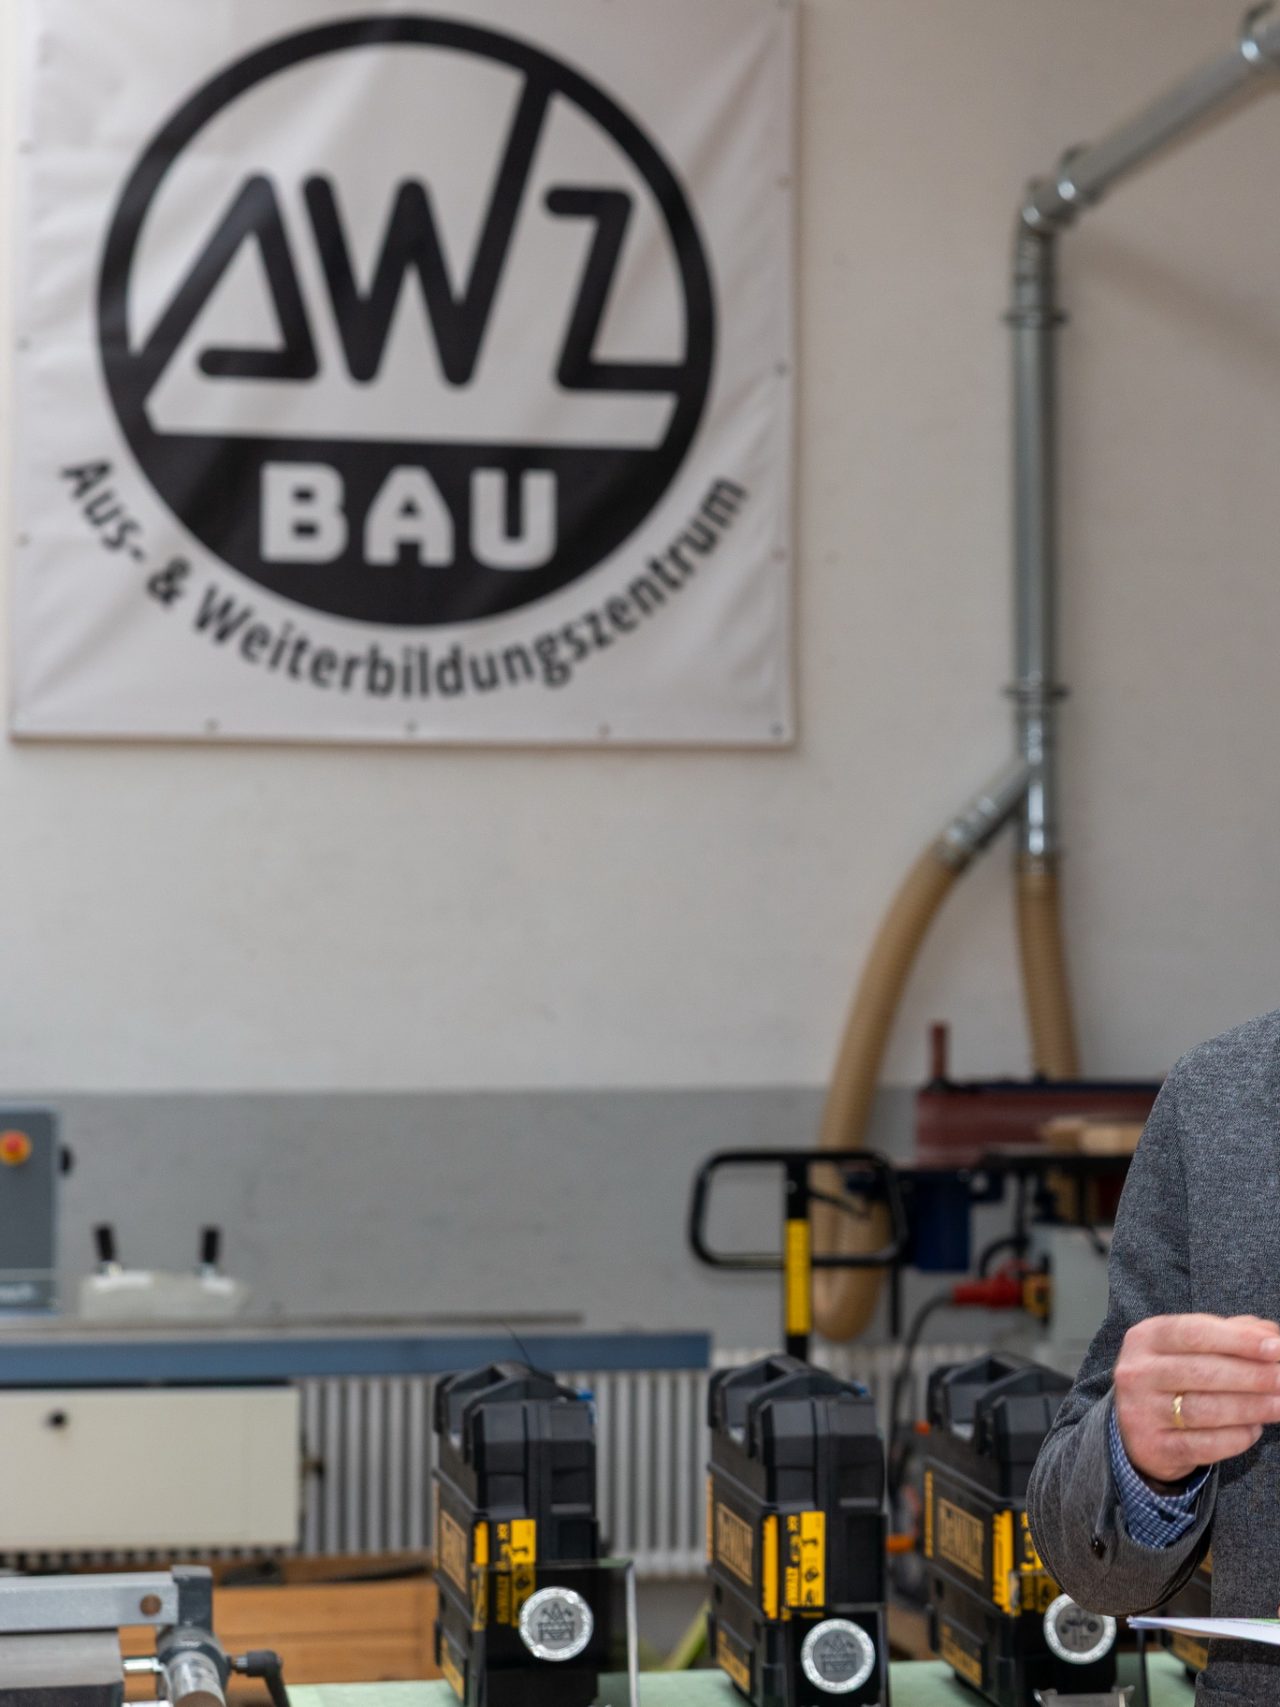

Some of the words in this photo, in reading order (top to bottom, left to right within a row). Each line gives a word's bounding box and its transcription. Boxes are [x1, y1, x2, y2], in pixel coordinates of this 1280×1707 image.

[130, 78, 690, 393] AWZ
[61, 459, 145, 564] Aus-
[146, 556, 192, 607] &
[195, 474, 747, 699] Weiterbildungszentrum
[260, 462, 557, 570] BAU
